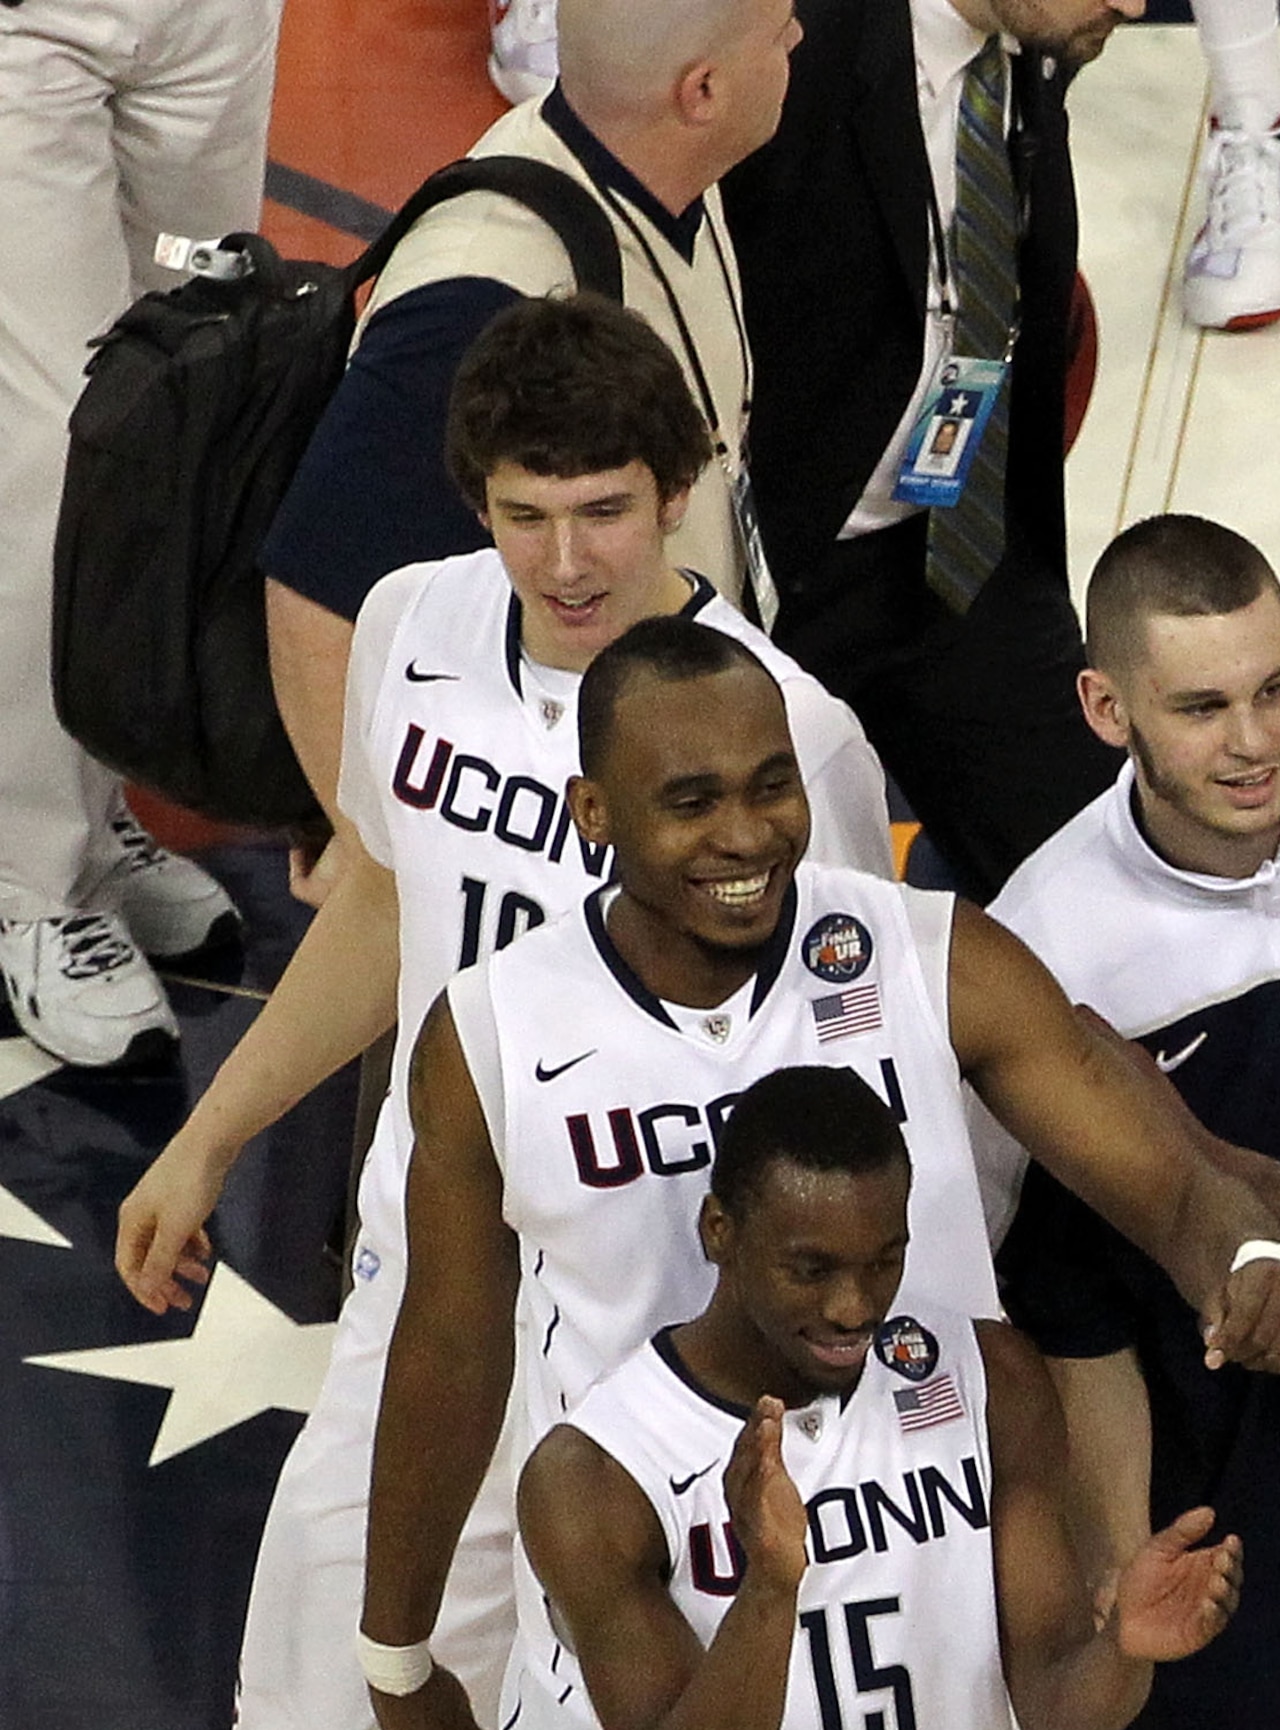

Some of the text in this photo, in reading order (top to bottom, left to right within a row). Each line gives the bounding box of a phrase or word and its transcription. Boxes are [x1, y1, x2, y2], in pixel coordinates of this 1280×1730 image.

[392, 722, 616, 880] UCON
[457, 874, 546, 972] 1
[689, 1456, 991, 1598] UONN
